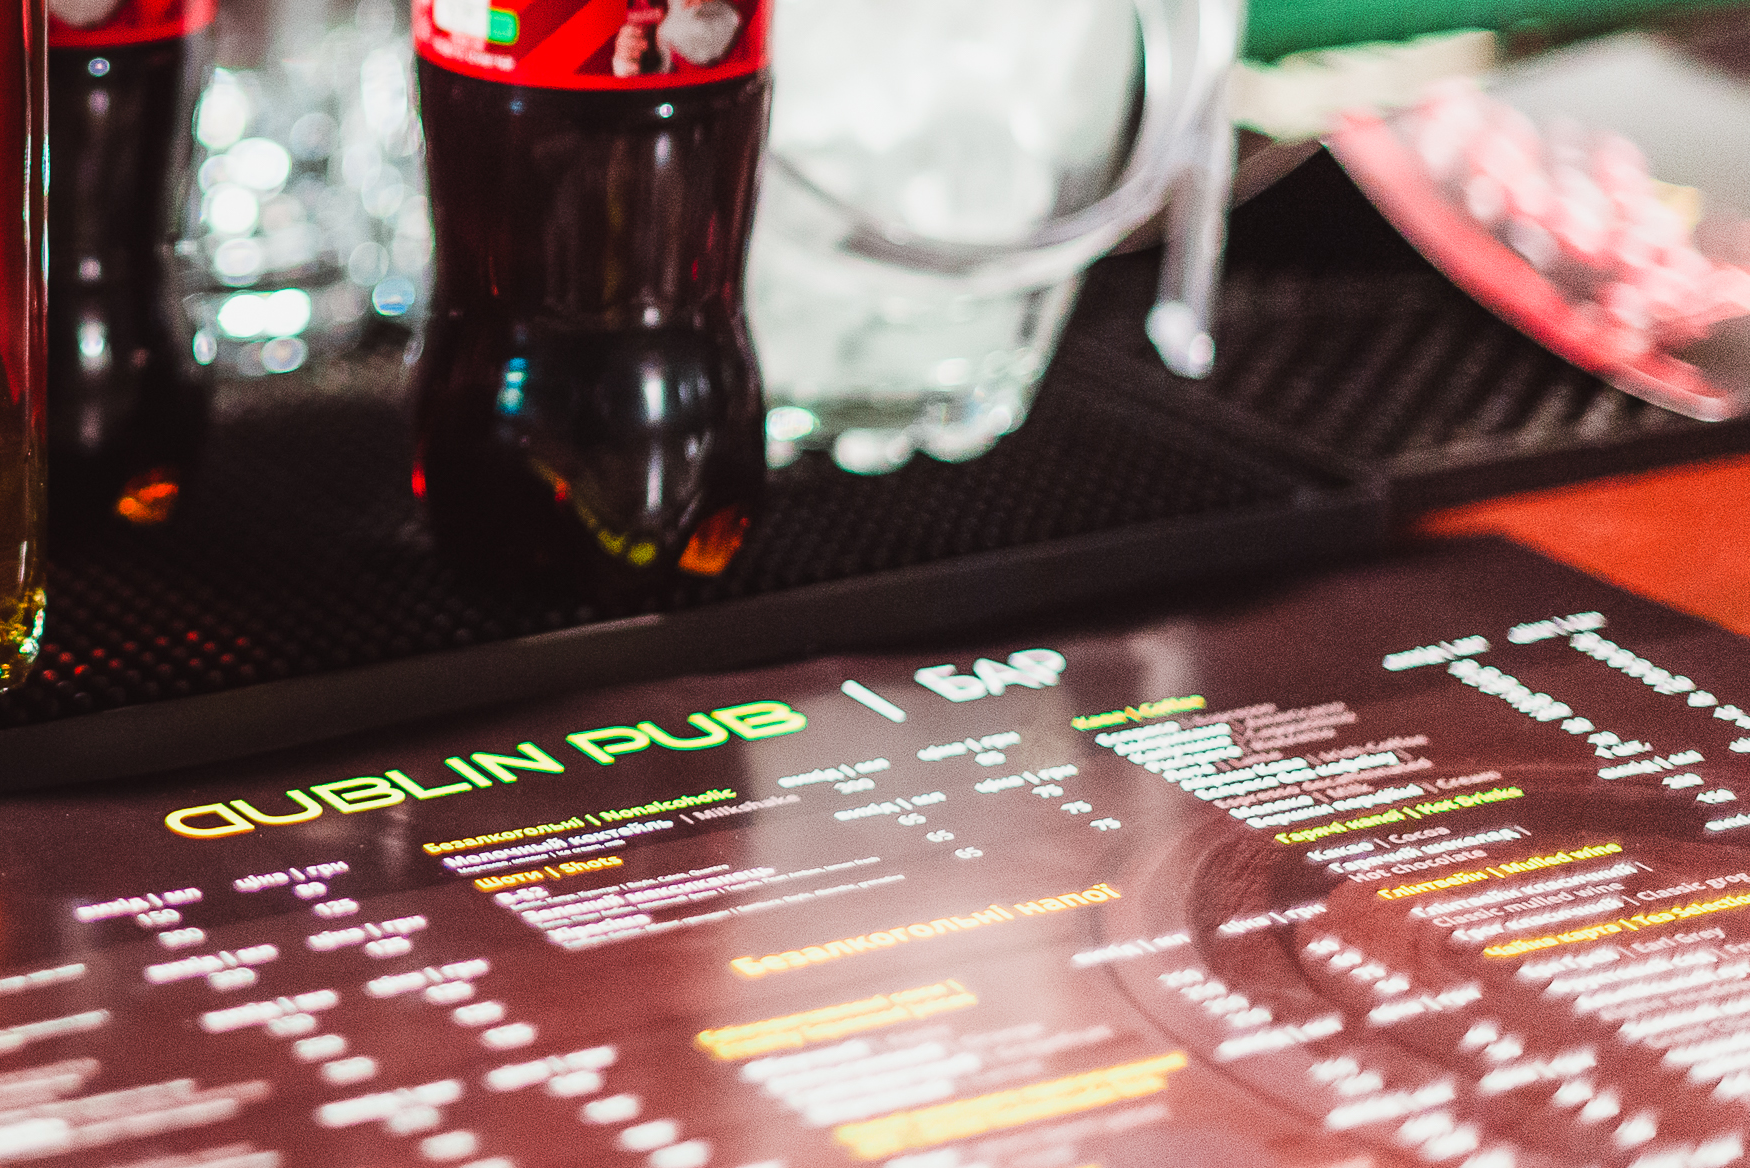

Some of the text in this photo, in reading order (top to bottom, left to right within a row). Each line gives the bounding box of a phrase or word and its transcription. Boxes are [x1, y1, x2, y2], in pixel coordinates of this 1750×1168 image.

[913, 647, 1066, 702] БАР
[164, 700, 808, 838] DUBLIN PUB
[421, 788, 737, 855] Безалкогольні Nonalcoholic
[443, 793, 801, 871] Молочный коктейль Milkshake
[925, 828, 955, 844] 65
[1088, 816, 1122, 831] 75
[953, 845, 984, 860] 65
[1306, 826, 1451, 862] Какао Cocoa
[473, 867, 544, 892] Шоти
[559, 854, 624, 876] Shots
[1349, 848, 1488, 883] Hot chocolate
[1376, 841, 1624, 900] Глінтвейн Mulled wine
[1432, 881, 1626, 928] Classic mulled wine
[1636, 881, 1707, 901] Classic
[730, 903, 1016, 978] Безалкогольні
[1013, 882, 1123, 918] напої
[1556, 922, 1623, 944] карта
[1631, 911, 1676, 927] Tea
[1671, 893, 1750, 919] Selectio
[1674, 927, 1727, 945] Grey
